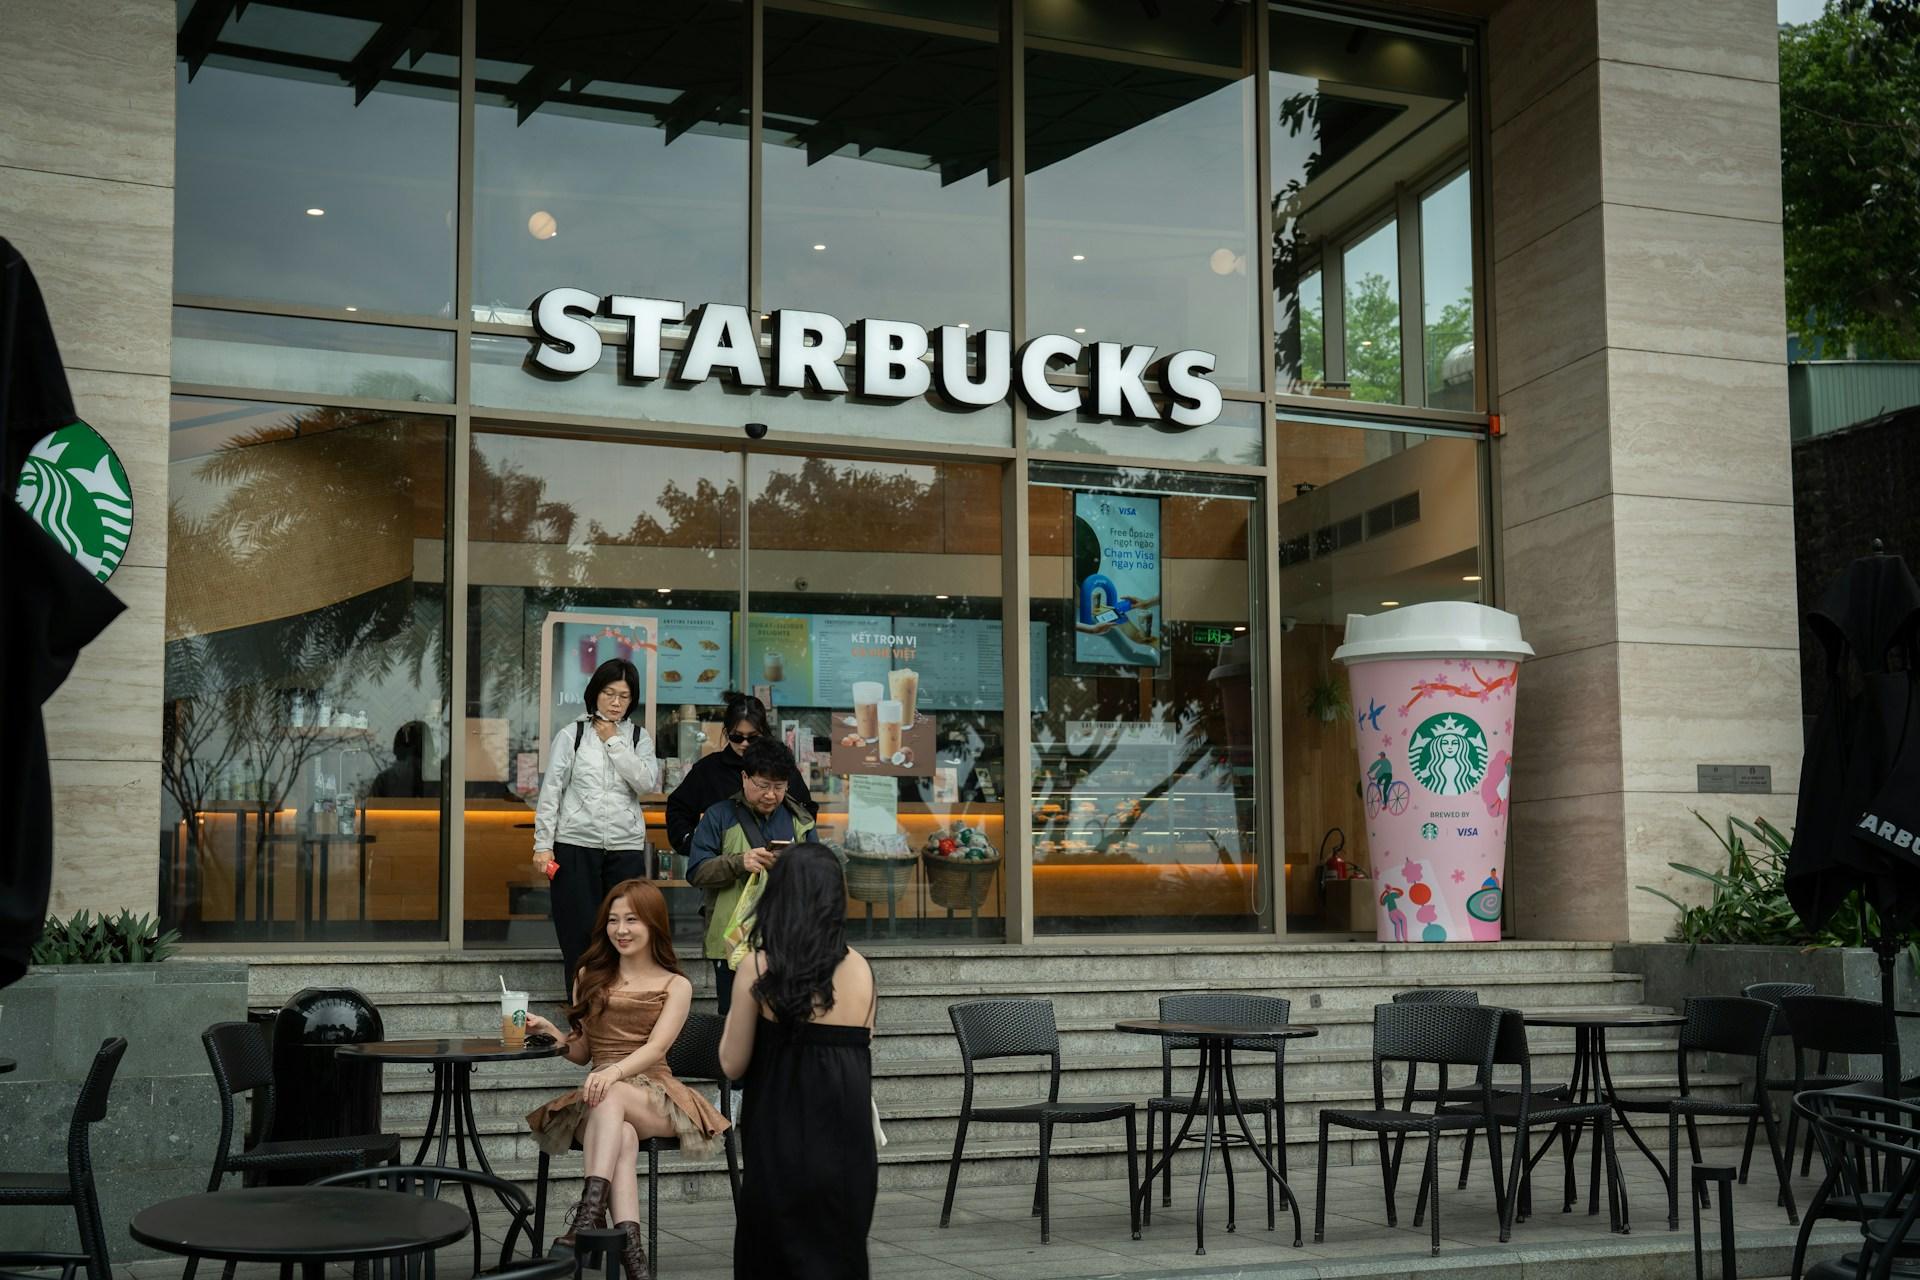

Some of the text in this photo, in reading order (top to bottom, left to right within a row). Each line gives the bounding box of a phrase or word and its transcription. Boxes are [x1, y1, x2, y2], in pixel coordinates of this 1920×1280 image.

[532, 286, 1223, 428] STARBUCKS
[1119, 507, 1136, 515] VISA
[1110, 527, 1128, 537] Free
[1134, 550, 1154, 560] Visa
[1111, 559, 1154, 570] ngay nào
[851, 631, 917, 649] KẾT TRỌN VỊ
[1457, 827, 1478, 836] VISA
[1858, 812, 1920, 856] ARB
